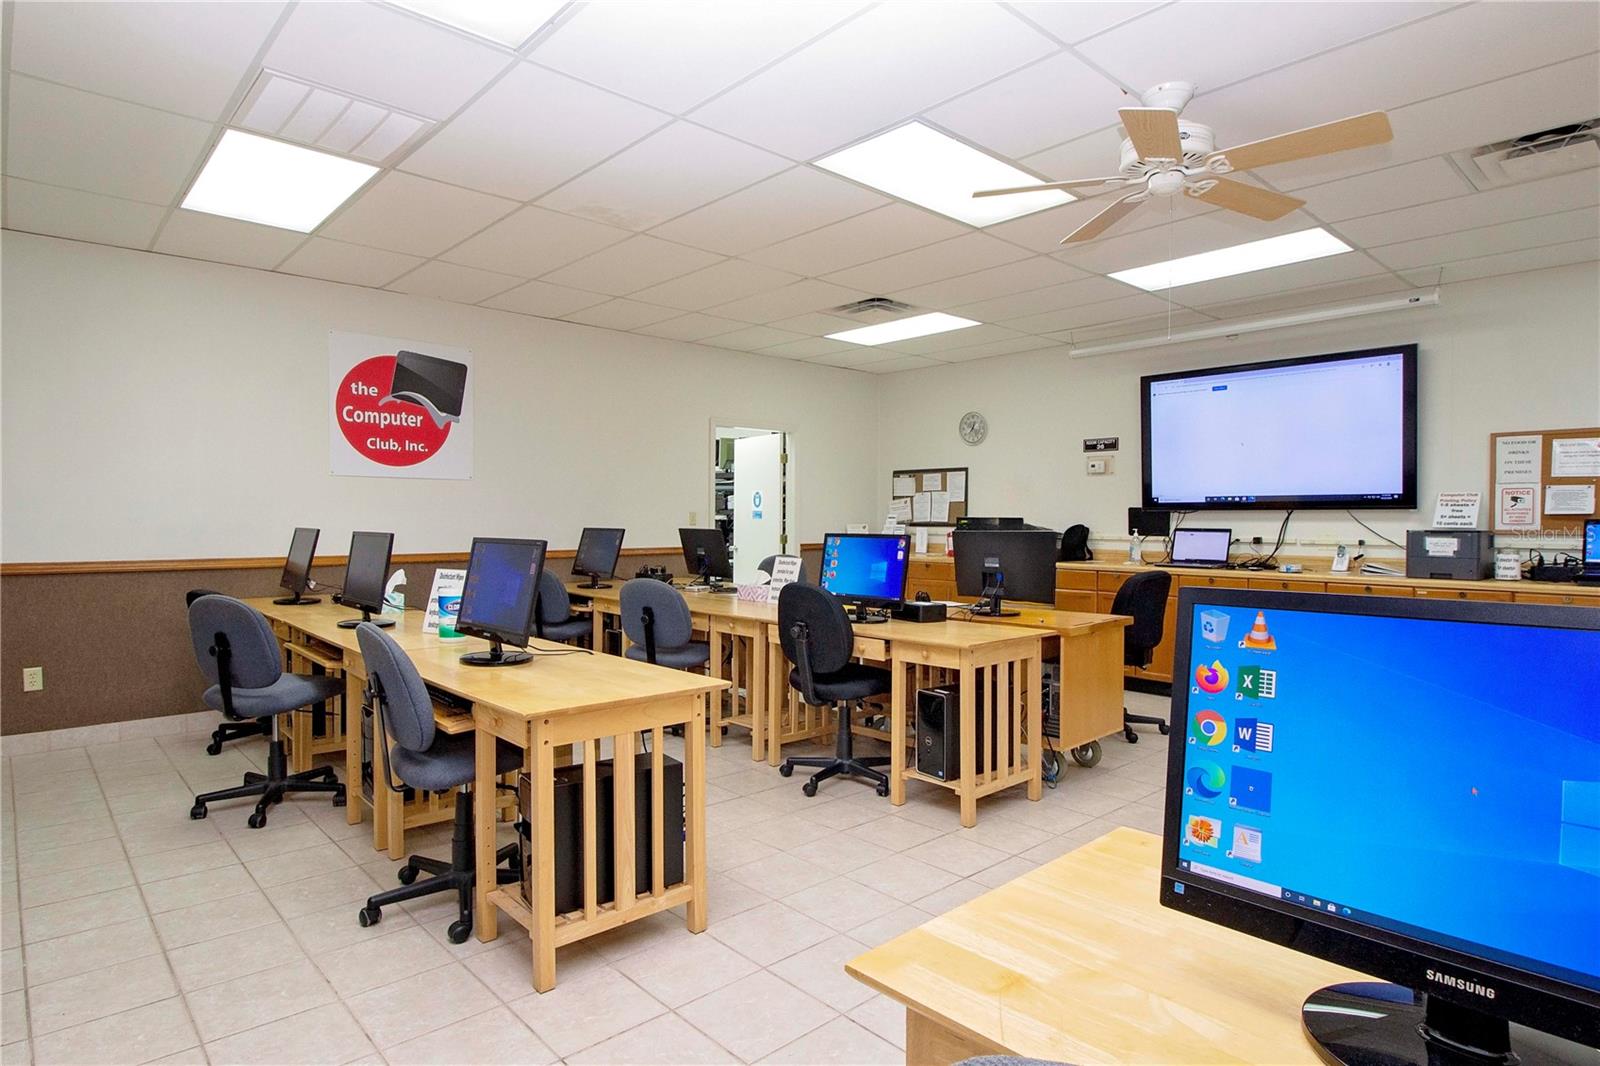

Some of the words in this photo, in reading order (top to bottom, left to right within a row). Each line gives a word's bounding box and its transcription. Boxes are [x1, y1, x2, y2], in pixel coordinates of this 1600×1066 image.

[351, 381, 378, 396] the
[342, 405, 424, 428] Computer
[366, 437, 401, 452] Club,
[405, 440, 429, 452] Inc.
[1425, 969, 1496, 999] SAMSUNG
